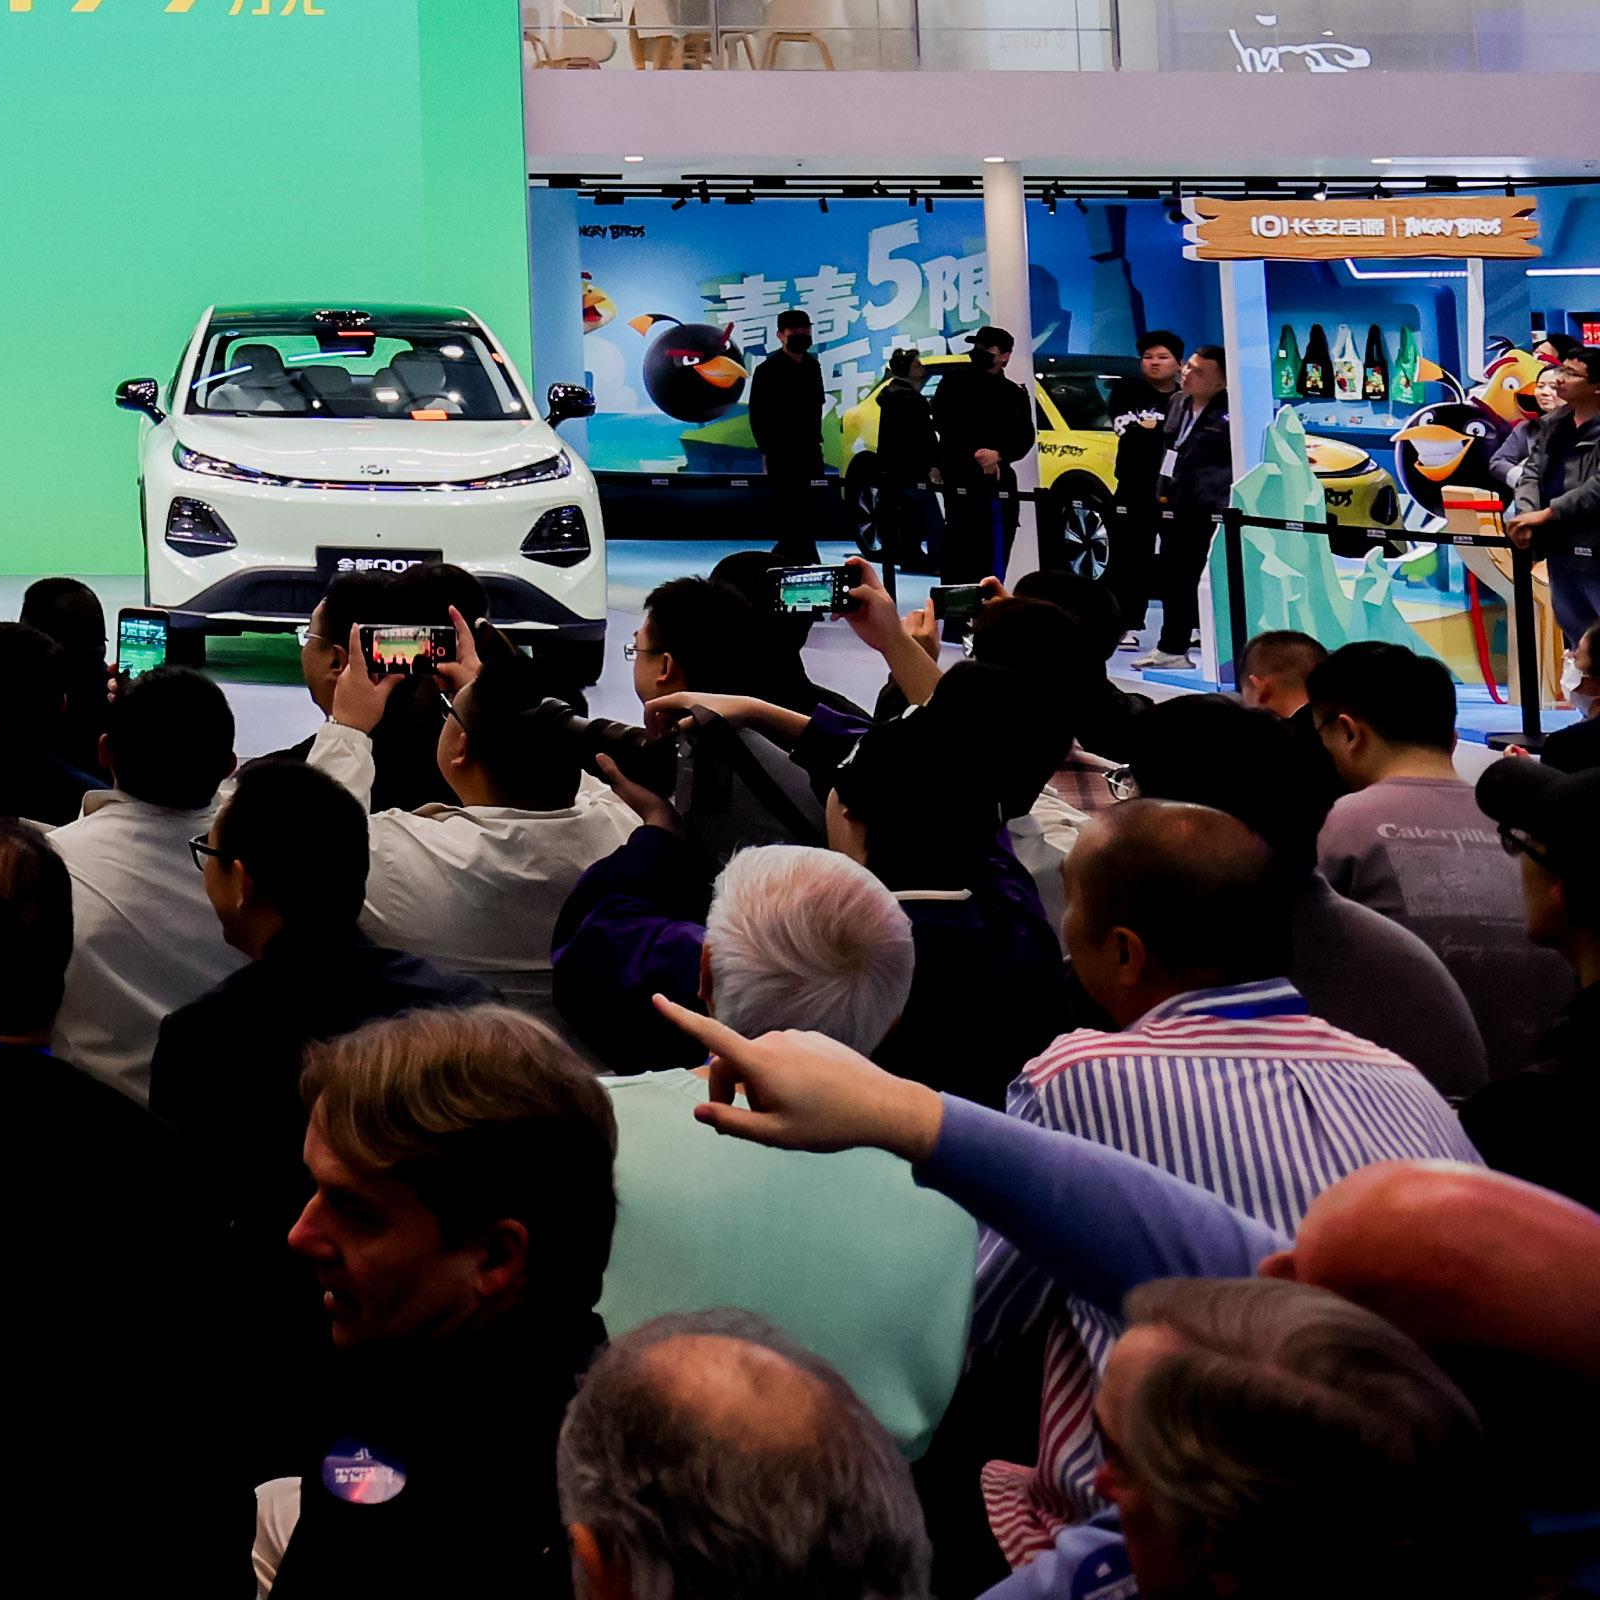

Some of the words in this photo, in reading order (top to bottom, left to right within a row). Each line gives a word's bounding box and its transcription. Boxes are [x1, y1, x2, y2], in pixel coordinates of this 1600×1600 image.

[608, 224, 646, 240] BIRDS
[1289, 217, 1386, 238] 长安启源
[1403, 217, 1455, 238] ANGRY
[1455, 217, 1502, 238] BIRDS
